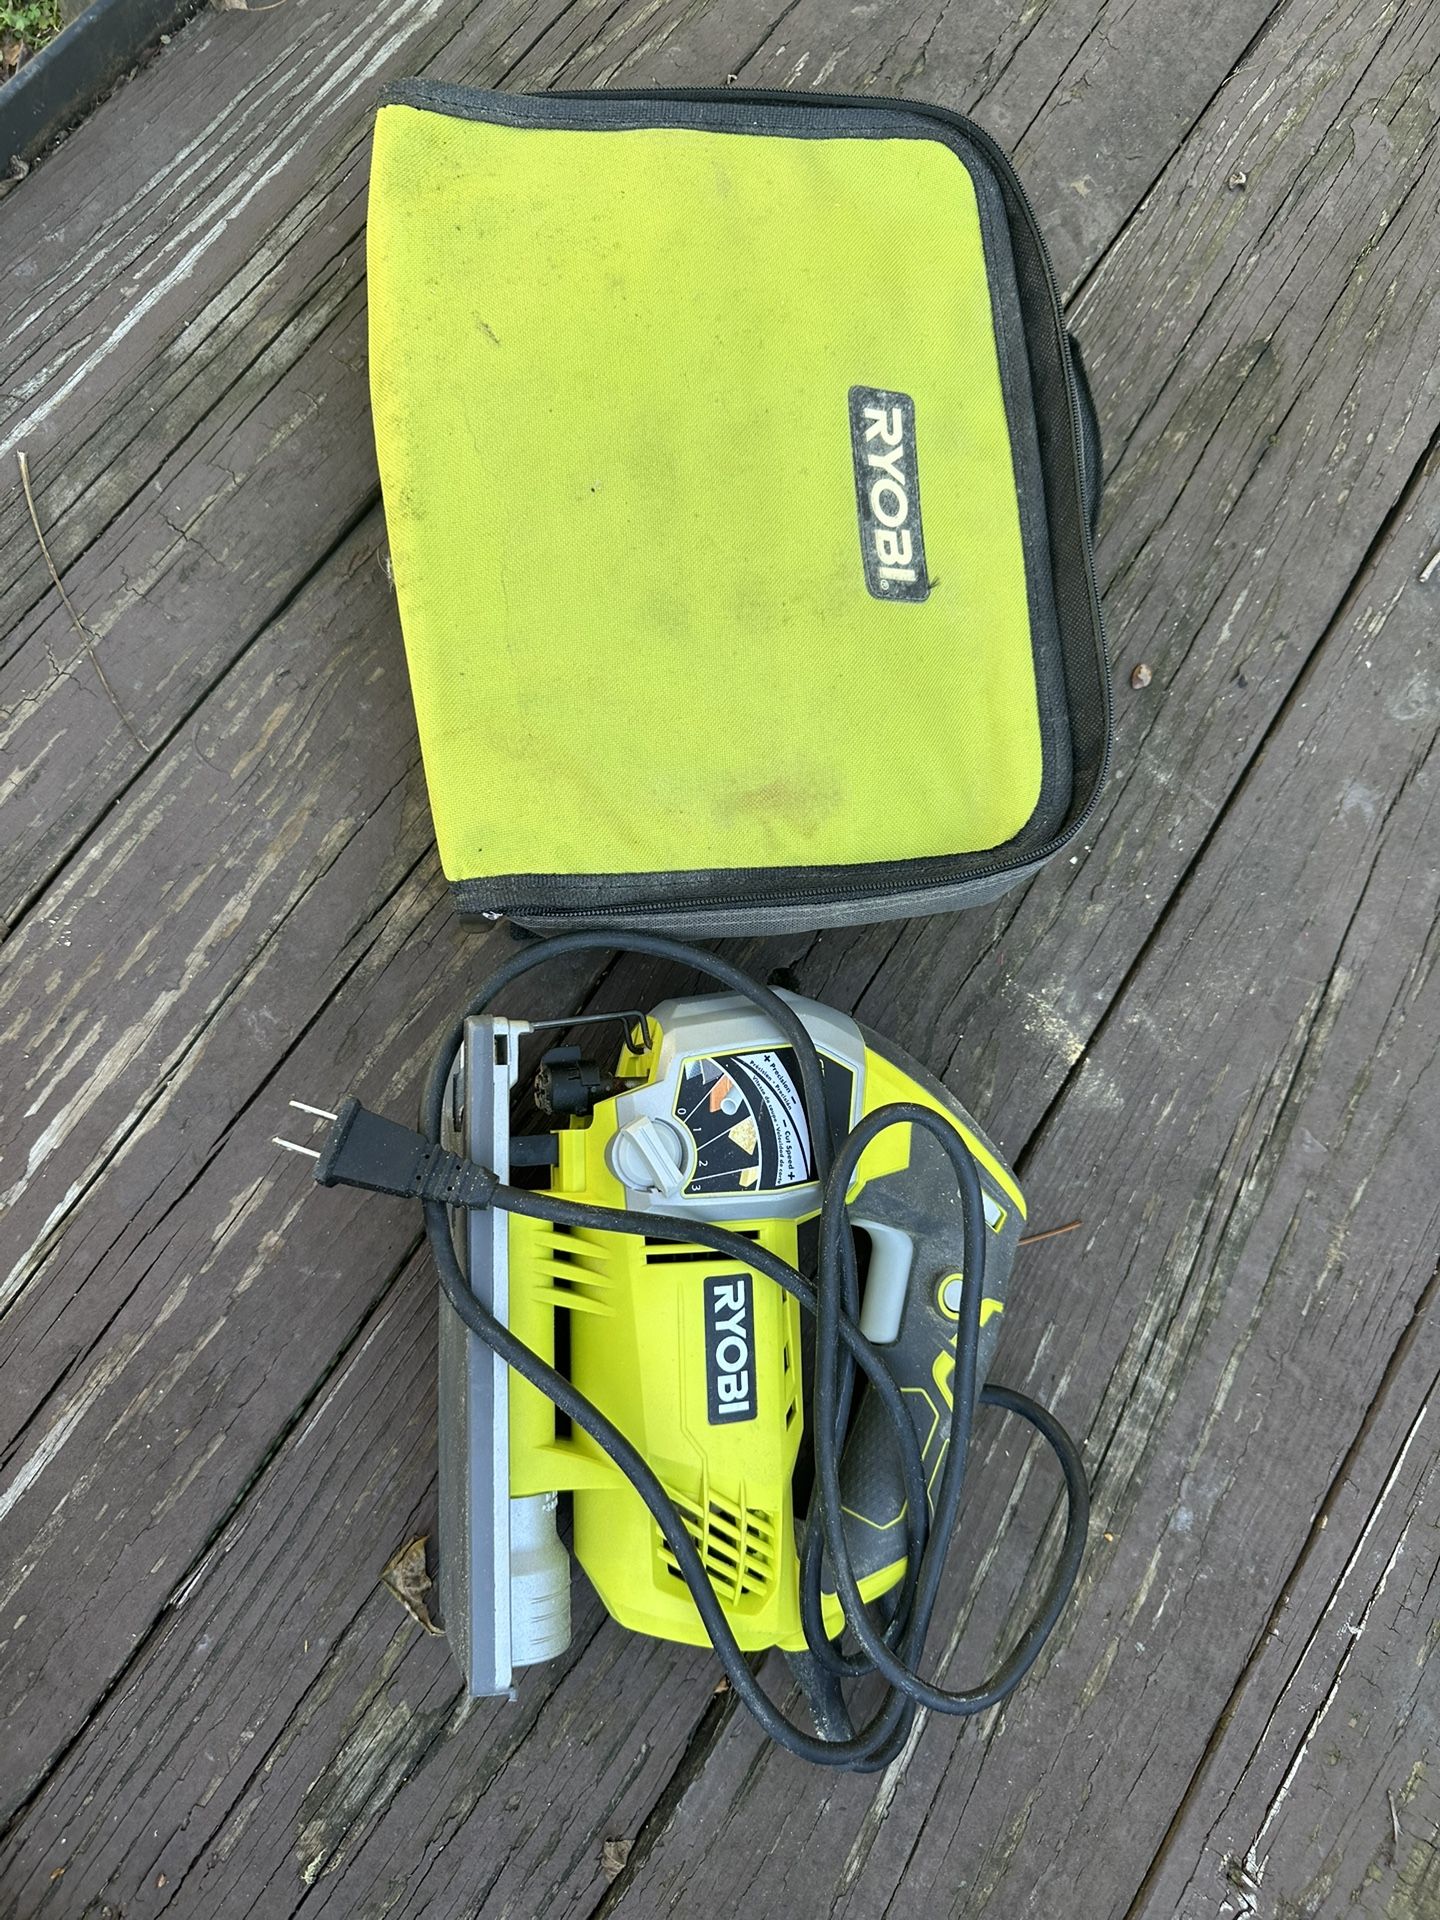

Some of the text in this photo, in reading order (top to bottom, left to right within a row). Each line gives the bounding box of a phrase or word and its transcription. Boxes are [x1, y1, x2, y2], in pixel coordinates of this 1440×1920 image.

[769, 1062, 792, 1093] Precision
[677, 1107, 687, 1115] 0
[785, 1145, 794, 1170] Speed
[713, 1280, 750, 1414] RYOBI
